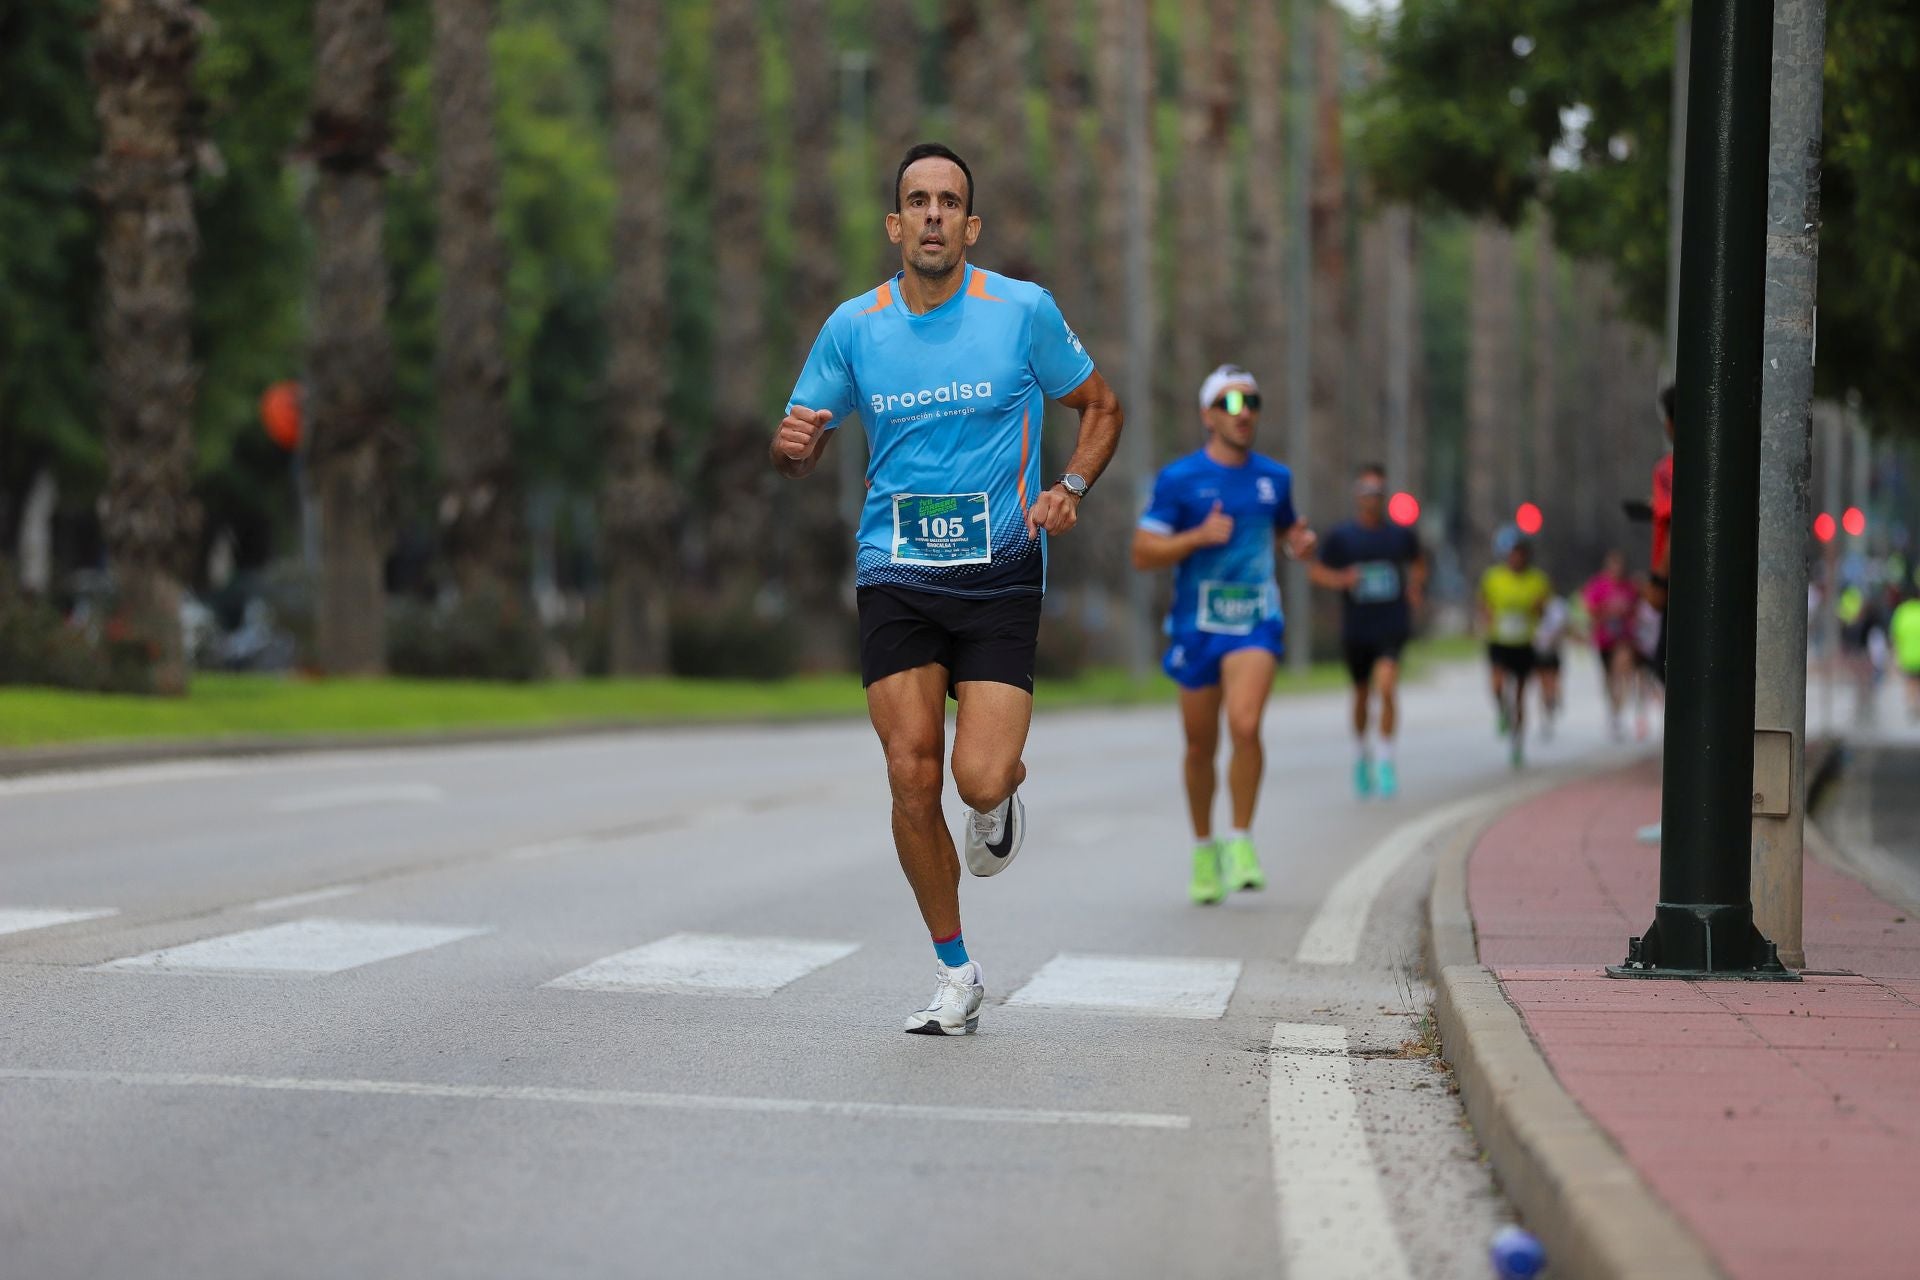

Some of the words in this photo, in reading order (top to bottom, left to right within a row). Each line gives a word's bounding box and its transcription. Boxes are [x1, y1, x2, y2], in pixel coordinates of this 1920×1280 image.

[871, 381, 992, 413] Brocalsa
[890, 412, 933, 424] innovación
[918, 517, 965, 538] 105
